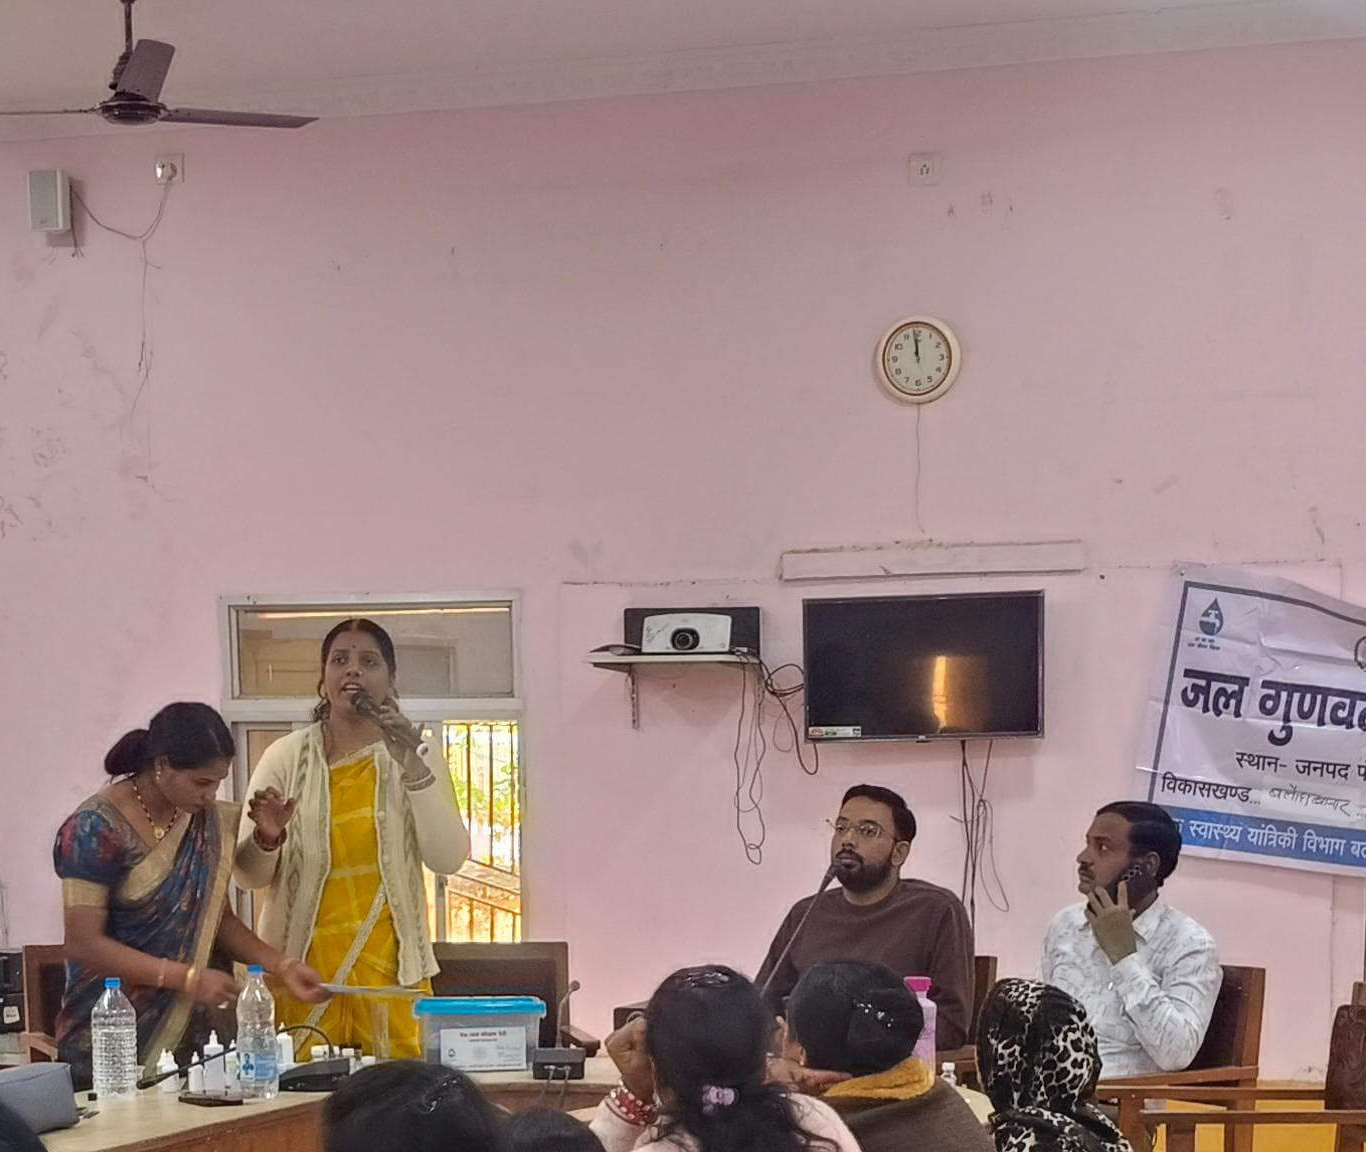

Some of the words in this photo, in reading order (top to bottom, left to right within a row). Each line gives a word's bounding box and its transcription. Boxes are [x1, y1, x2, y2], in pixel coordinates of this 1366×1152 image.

[894, 343, 903, 351] 10
[915, 379, 922, 387] 6
[1180, 668, 1251, 718] जल
[1295, 758, 1351, 781] जनपद
[1188, 820, 1244, 844] स्वास्थ्य
[1247, 823, 1298, 850] यांत्रिकी
[1302, 829, 1347, 856] विभाग
